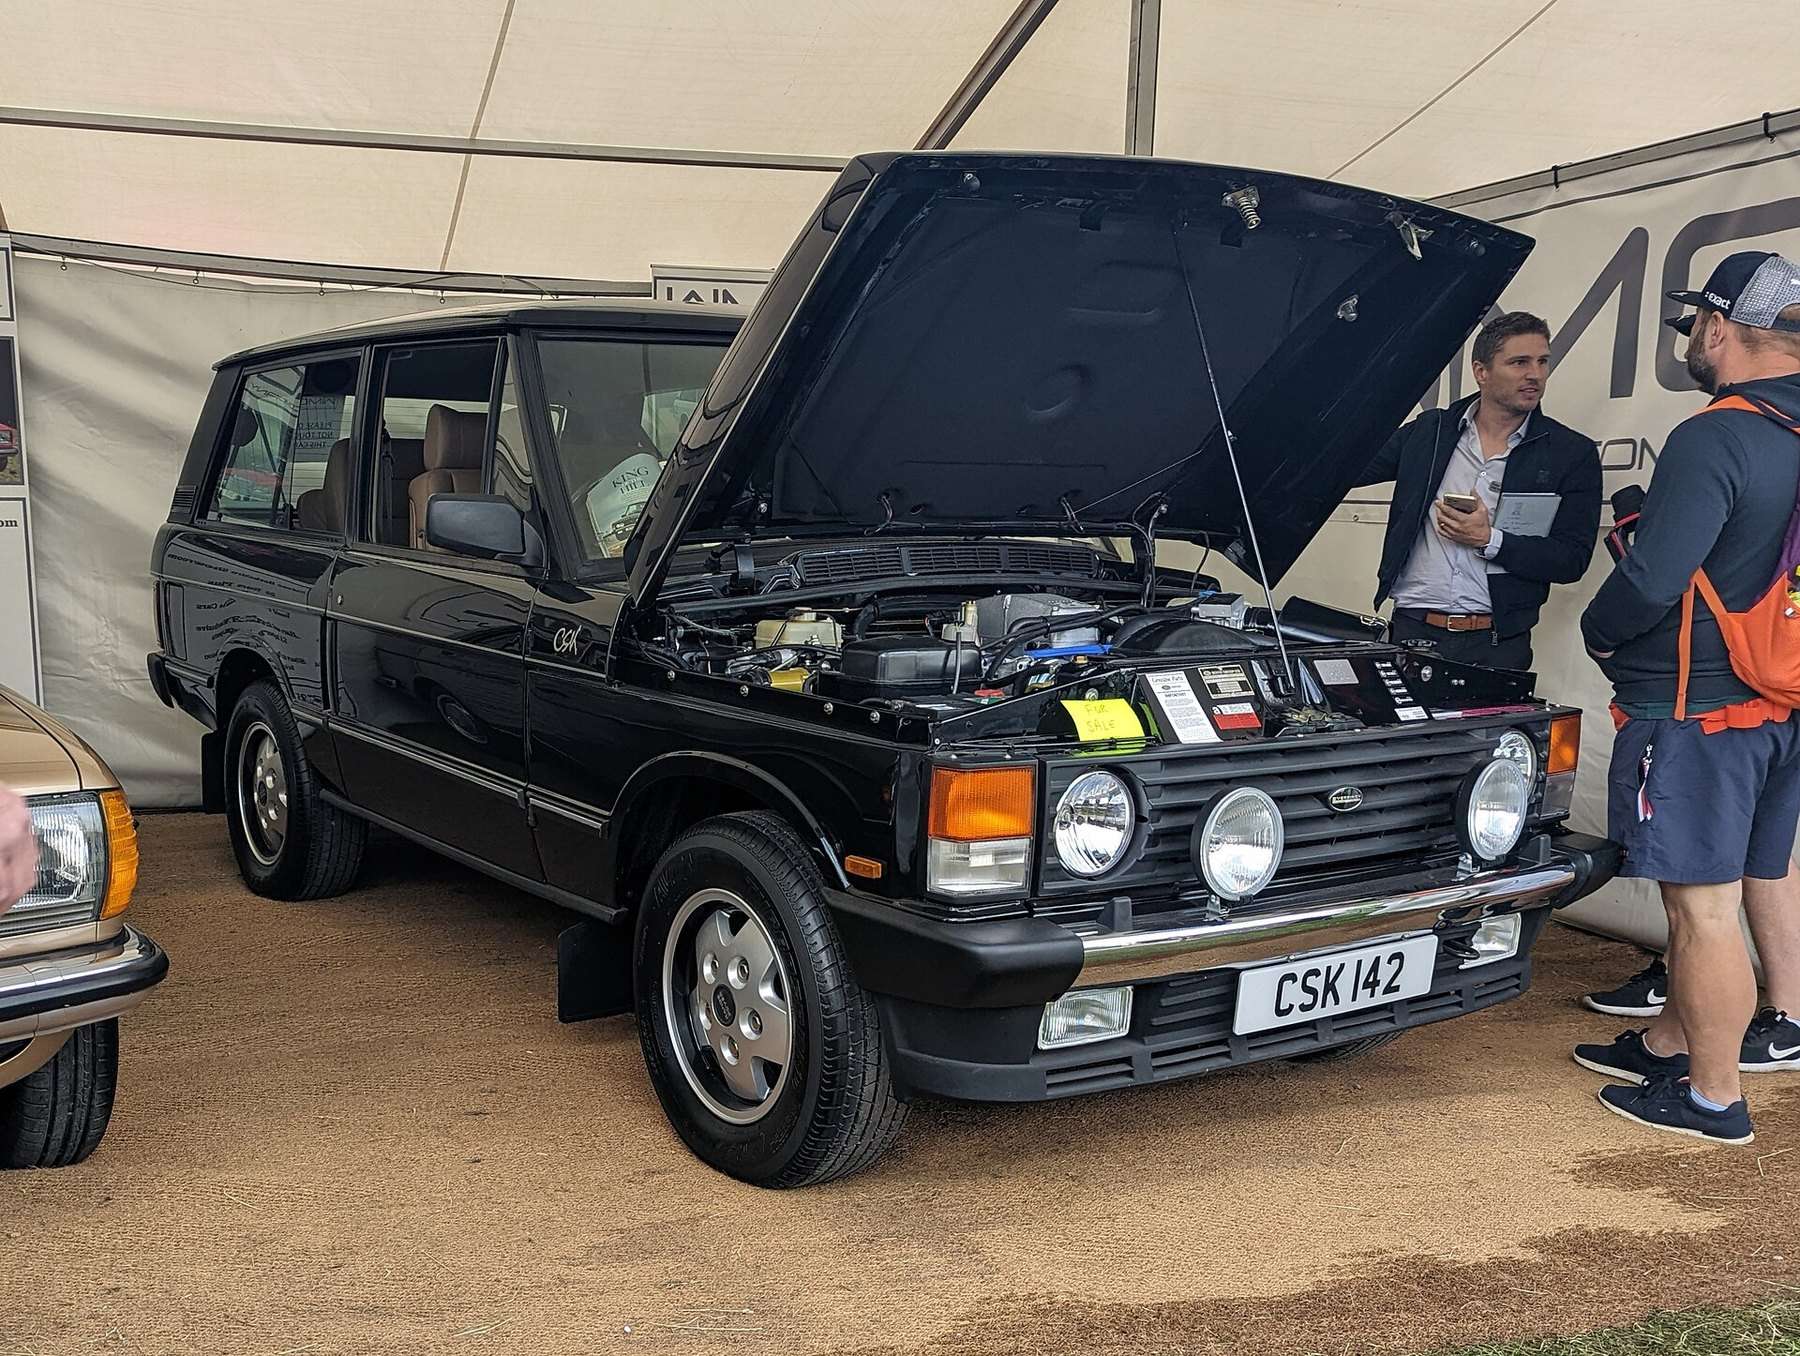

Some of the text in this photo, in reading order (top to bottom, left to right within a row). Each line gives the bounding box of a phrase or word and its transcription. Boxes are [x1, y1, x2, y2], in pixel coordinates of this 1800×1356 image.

[612, 465, 649, 488] KING
[1085, 719, 1116, 733] SALE
[1274, 951, 1405, 1018] CSK 142
